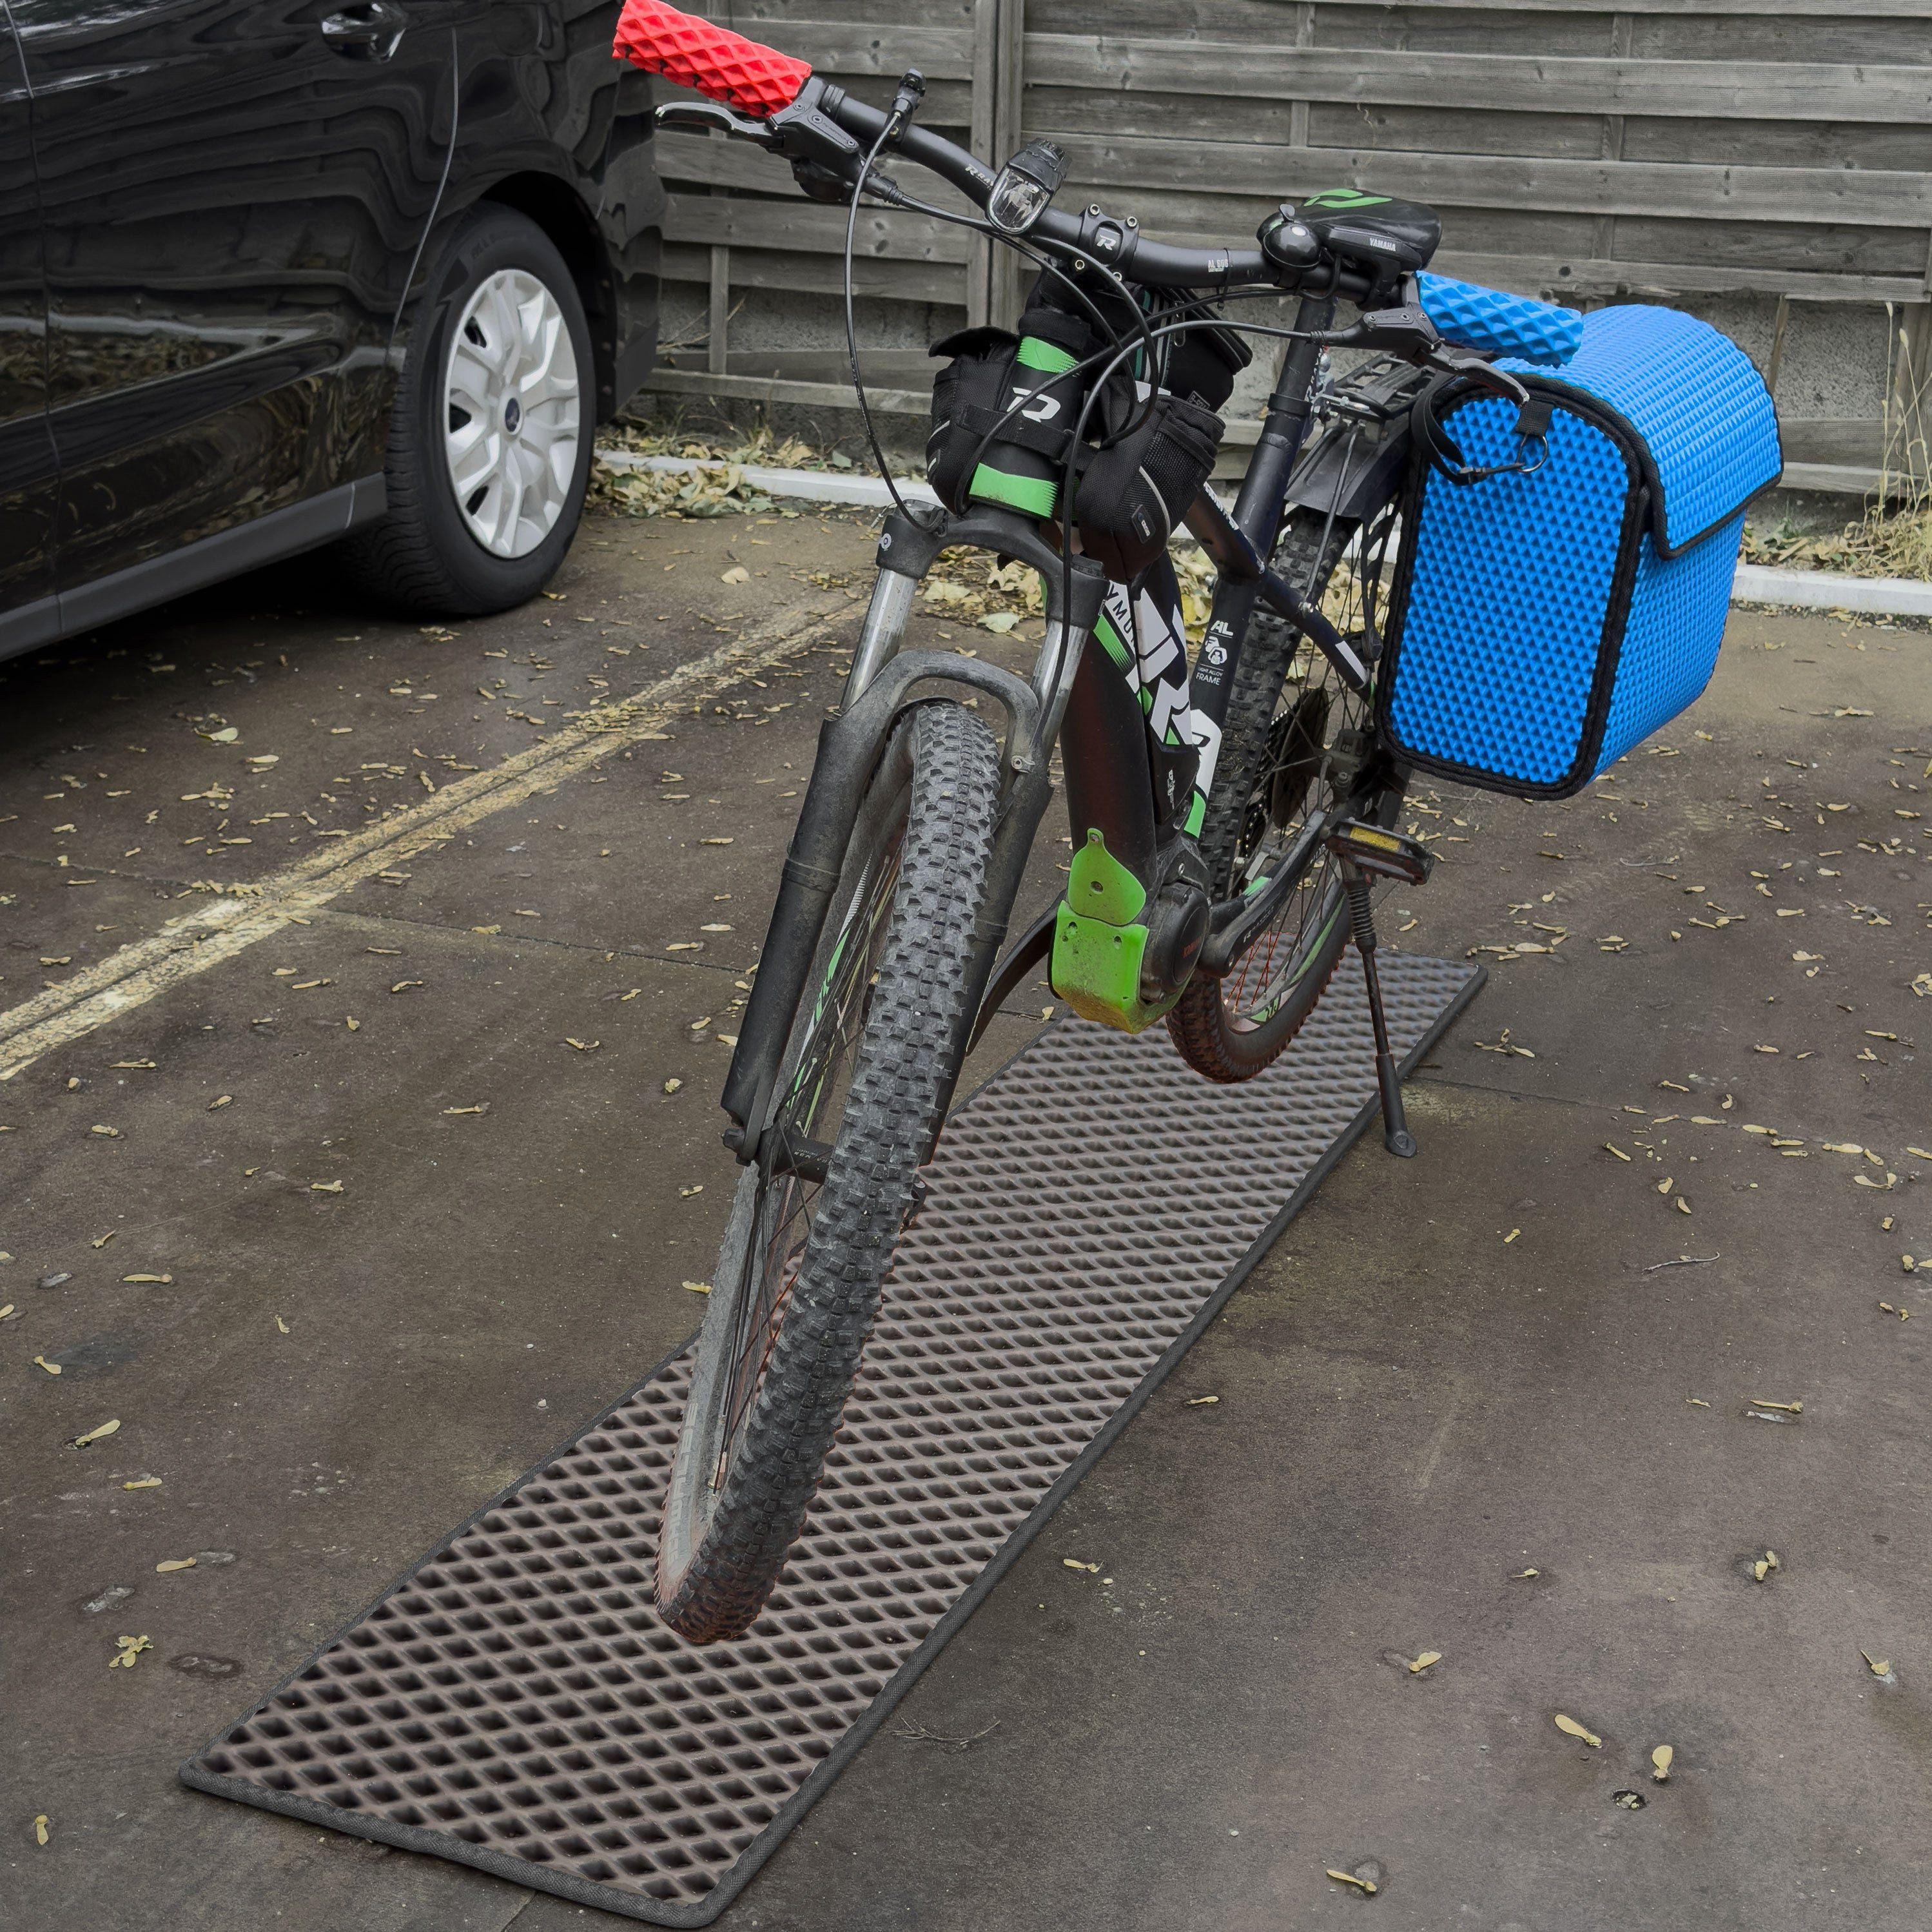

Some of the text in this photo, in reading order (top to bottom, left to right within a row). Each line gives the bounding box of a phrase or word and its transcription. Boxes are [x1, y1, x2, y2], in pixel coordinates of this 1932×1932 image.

[1370, 237, 1396, 252] YAMAHA
[1210, 620, 1234, 636] AL
[1196, 672, 1221, 686] FRAME
